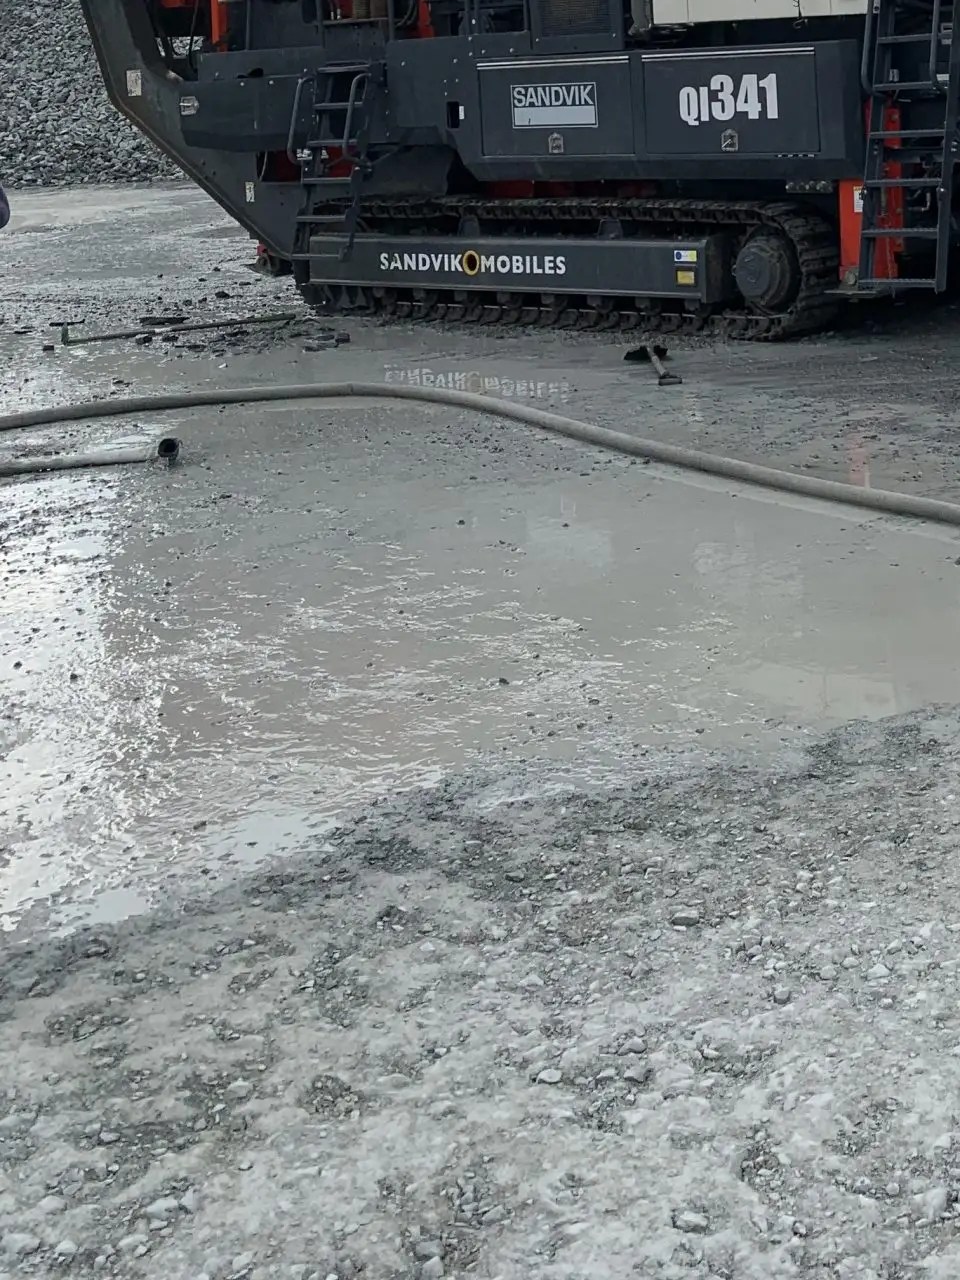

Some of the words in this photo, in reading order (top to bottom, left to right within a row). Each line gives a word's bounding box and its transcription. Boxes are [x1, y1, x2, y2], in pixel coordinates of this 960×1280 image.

[513, 85, 594, 107] SANDVIK
[679, 73, 779, 126] QI341
[380, 252, 463, 272] SANDVIK
[480, 255, 567, 275] MOBILES
